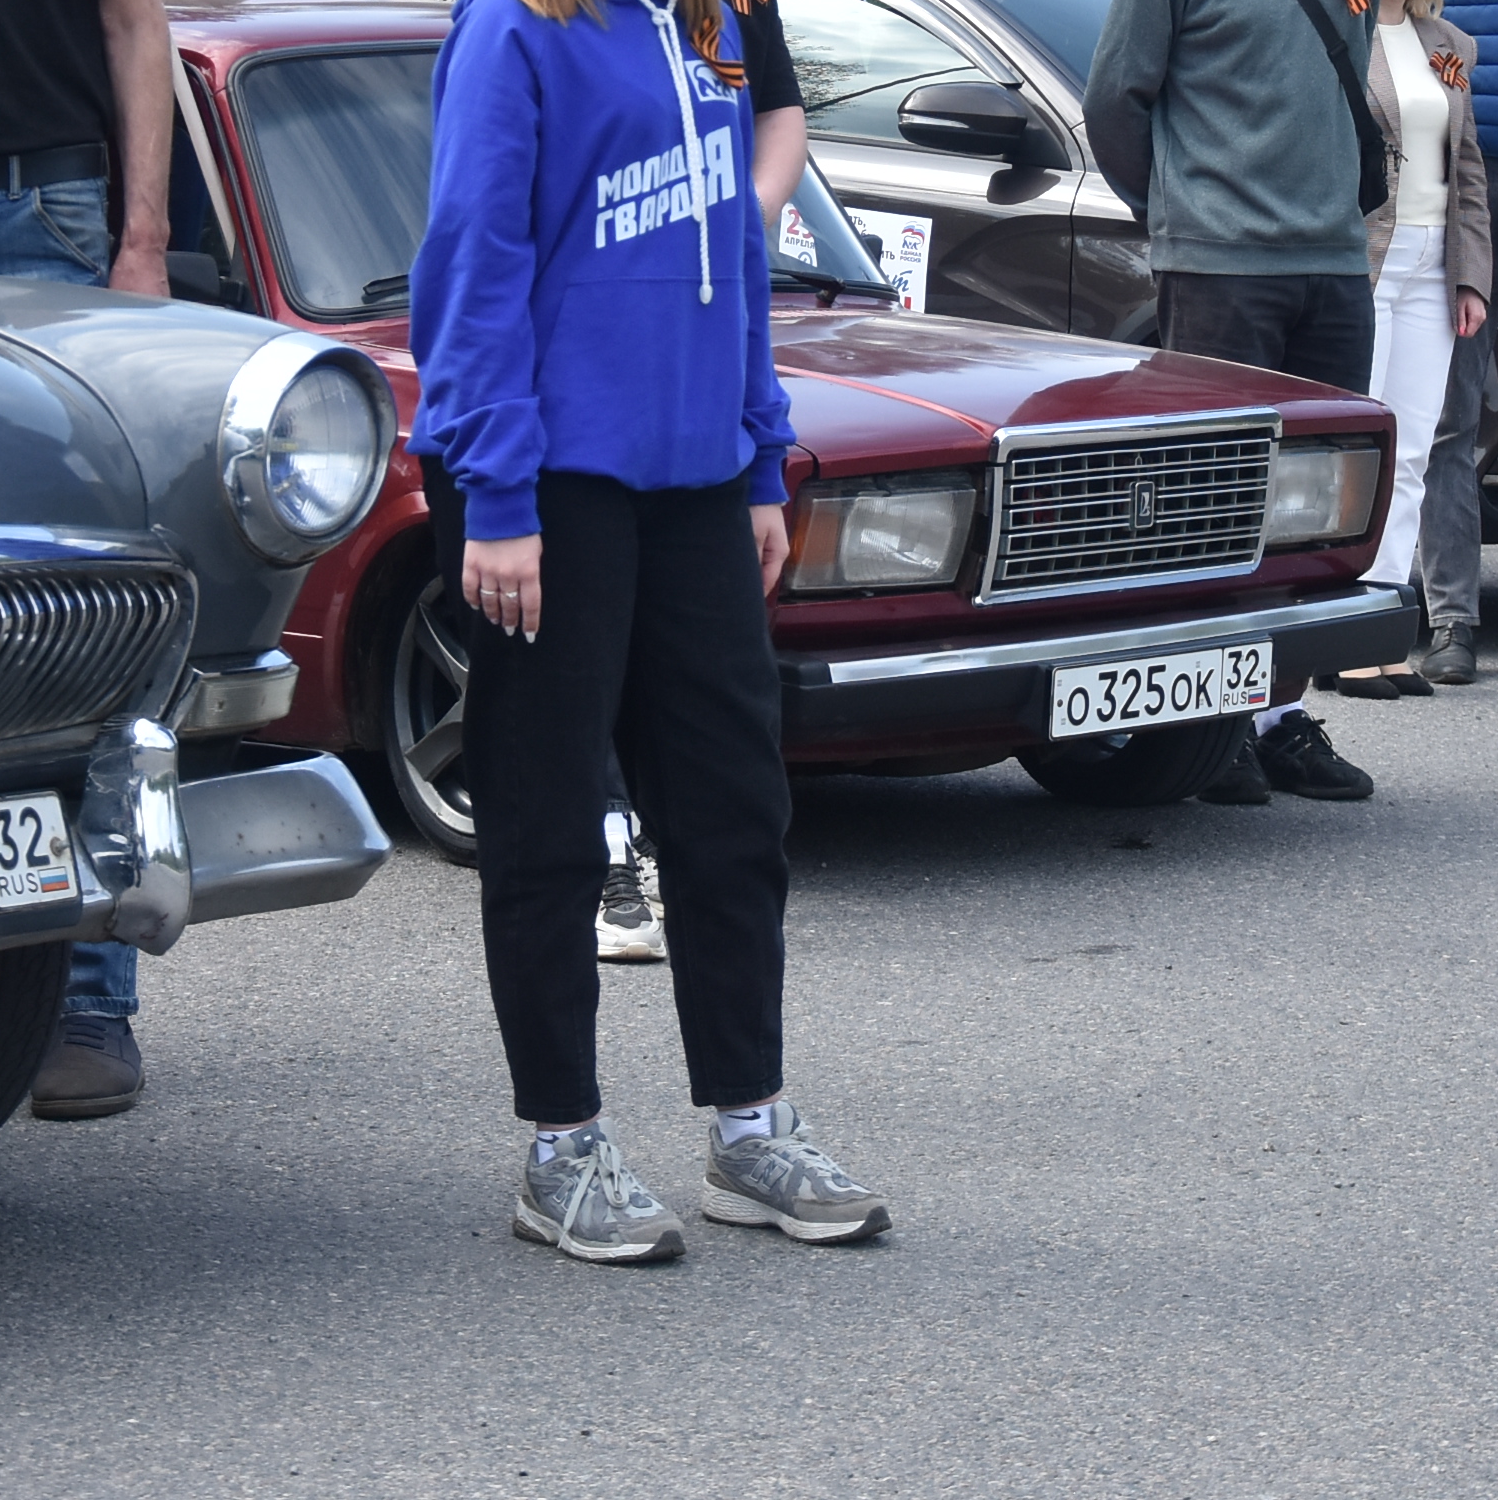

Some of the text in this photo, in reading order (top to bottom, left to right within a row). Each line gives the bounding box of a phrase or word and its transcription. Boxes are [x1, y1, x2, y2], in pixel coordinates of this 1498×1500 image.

[784, 236, 816, 250] АПРЕЛЯ
[1067, 649, 1260, 726] О325ОК 32
[1223, 691, 1247, 708] RUS
